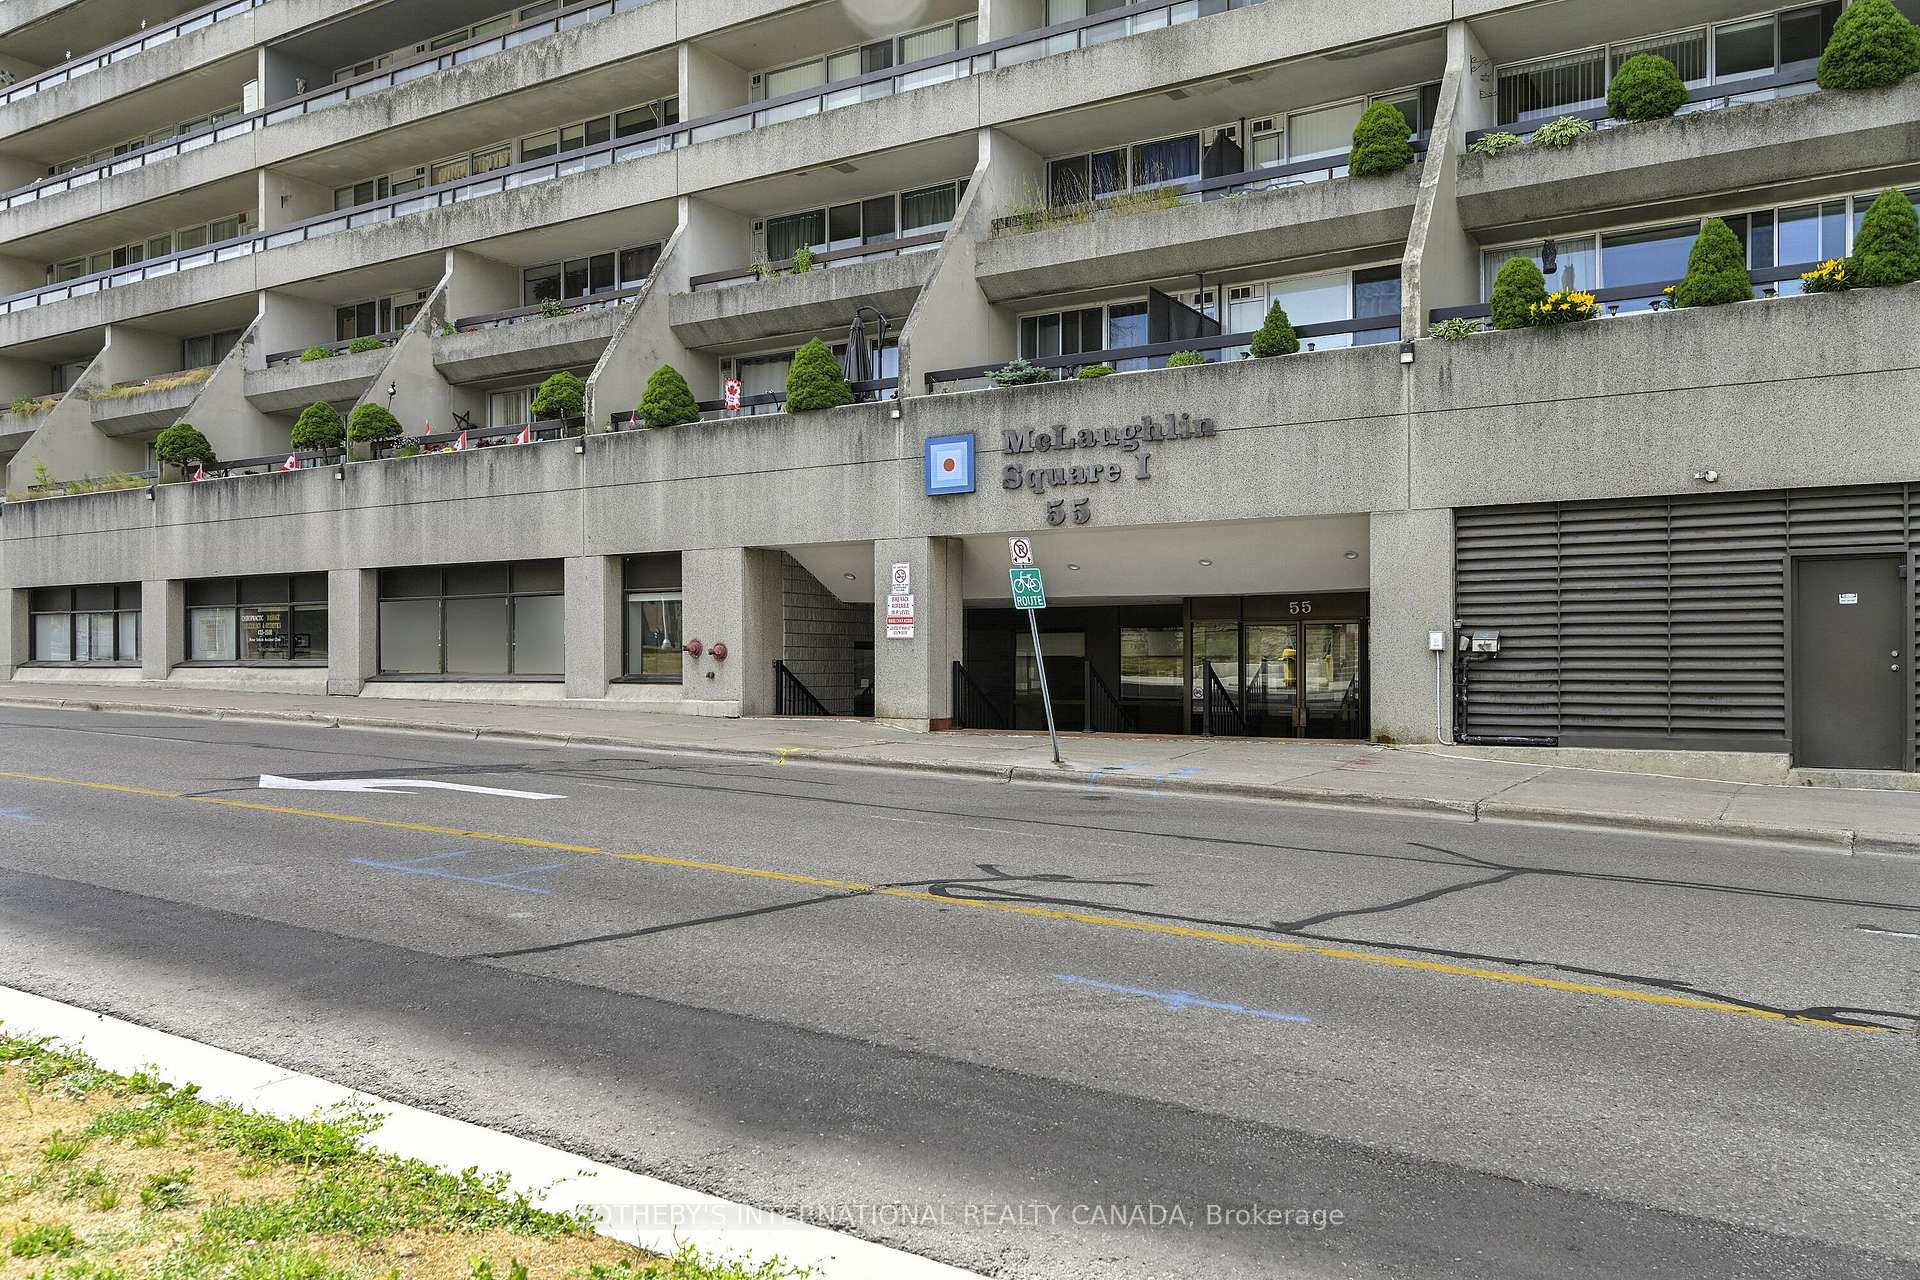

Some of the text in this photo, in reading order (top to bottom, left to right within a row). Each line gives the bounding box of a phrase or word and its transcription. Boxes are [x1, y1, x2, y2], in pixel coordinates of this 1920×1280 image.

[1001, 412, 1216, 455] McLaughlin
[1002, 452, 1151, 494] Square I
[1046, 497, 1091, 526] 55
[1016, 595, 1044, 607] ROUTE
[1289, 600, 1312, 615] 55
